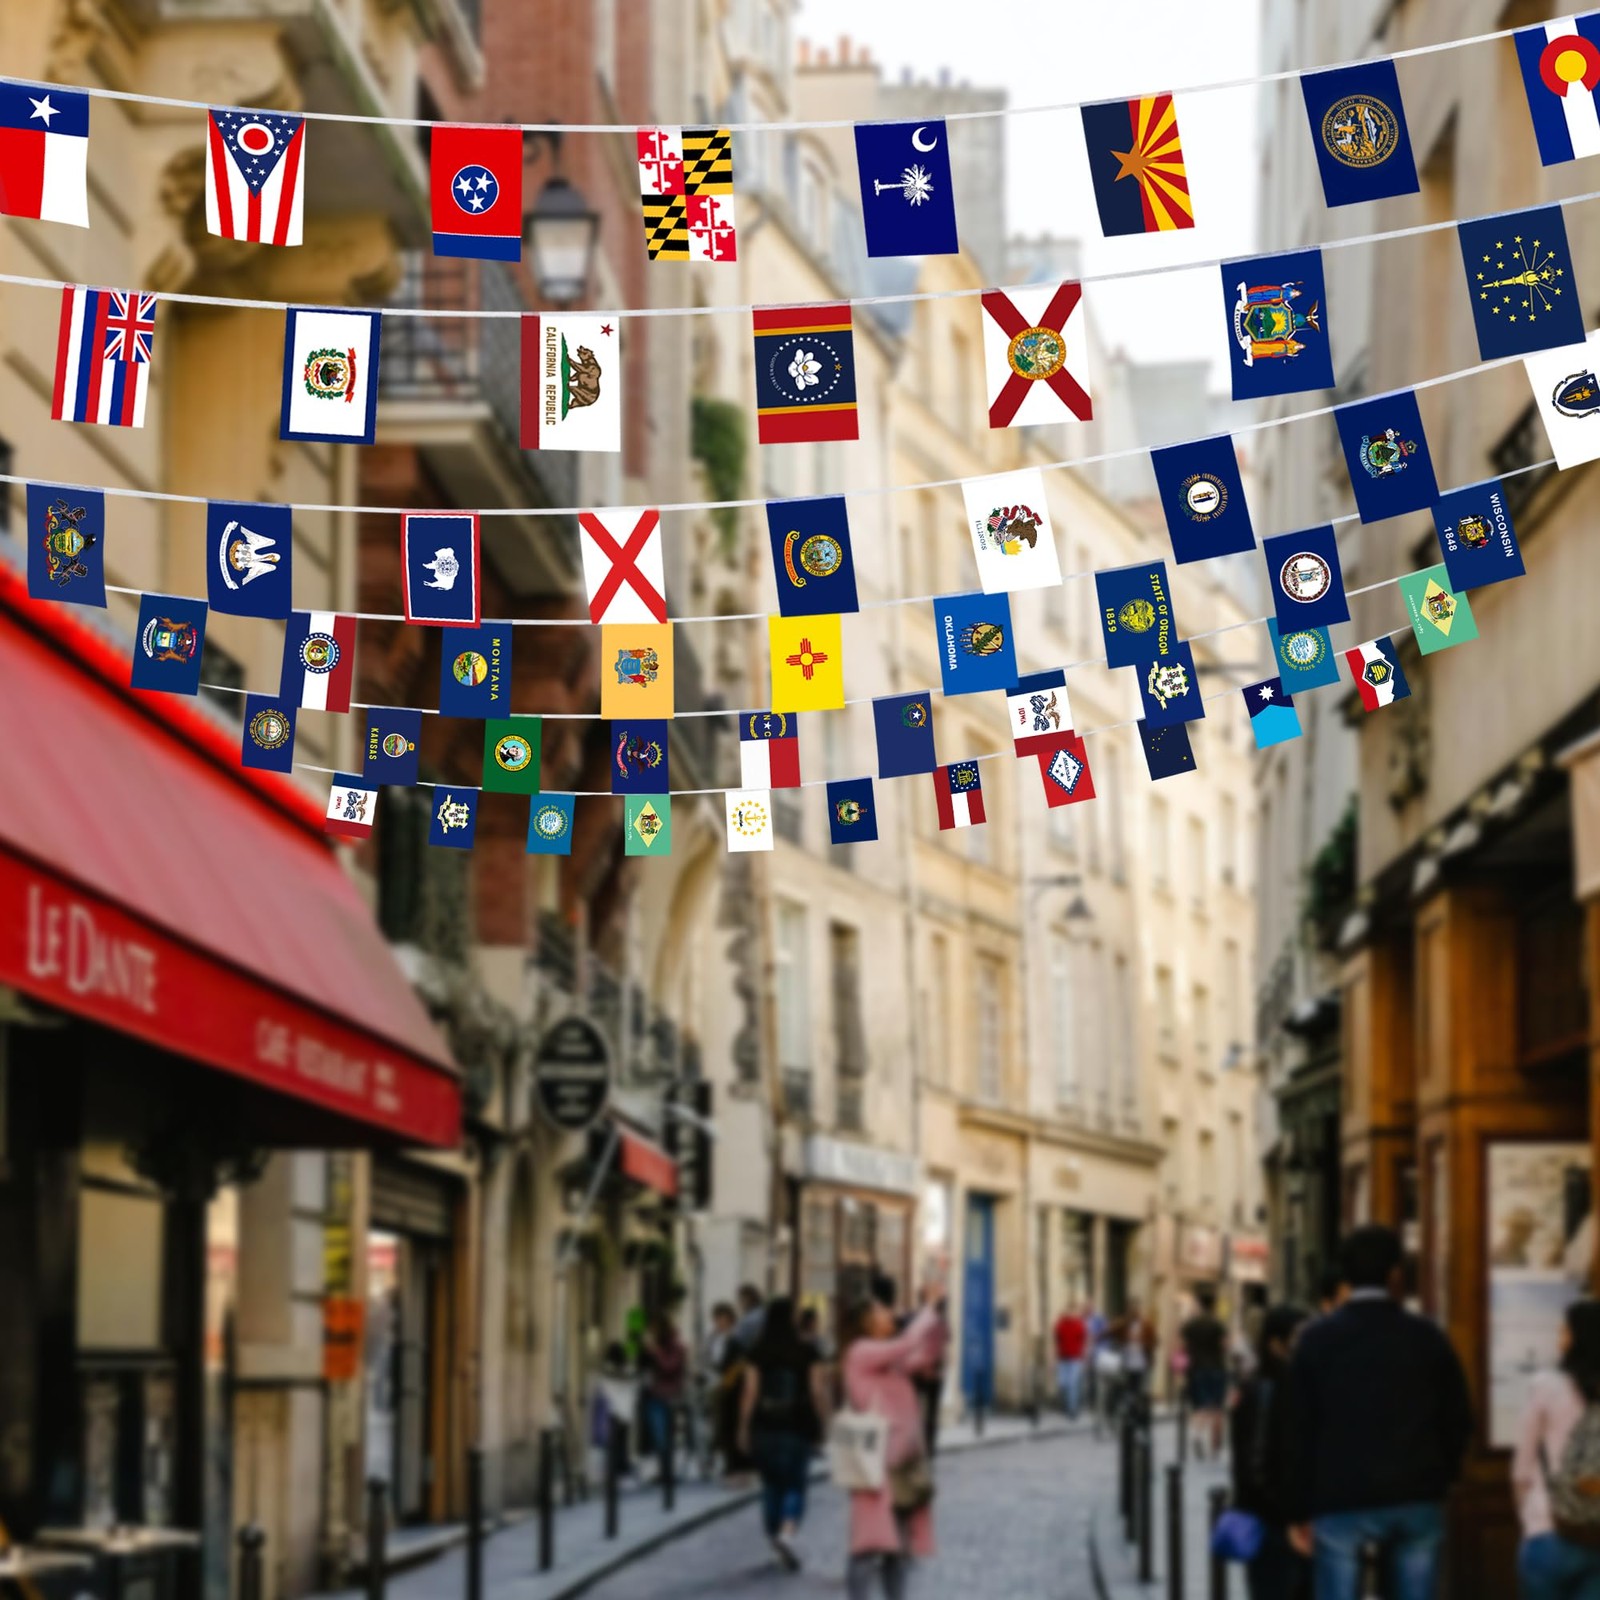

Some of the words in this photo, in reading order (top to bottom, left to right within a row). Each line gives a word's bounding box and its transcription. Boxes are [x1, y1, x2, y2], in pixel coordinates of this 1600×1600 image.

[545, 326, 557, 378] CALIFORNIA
[545, 384, 557, 426] REPUBLIC
[975, 520, 988, 551] ILLINOIS
[1443, 526, 1458, 552] 1848
[1490, 493, 1514, 558] WISCONSIN
[1149, 573, 1165, 603] STATE
[1105, 607, 1117, 633] 1859
[1158, 604, 1168, 616] OF
[944, 615, 958, 671] OKLAHOMA
[1158, 618, 1169, 656] OREGON
[1310, 628, 1324, 643] SOUTH
[1316, 643, 1326, 664] DAKOTA
[490, 638, 501, 701] MONTANA
[1018, 707, 1027, 725] IOWA
[368, 727, 379, 760] KANSAS
[1062, 757, 1072, 782] ARKANSAS
[335, 796, 343, 810] IOWA
[28, 885, 61, 979] LE
[68, 904, 157, 1014] DANTE
